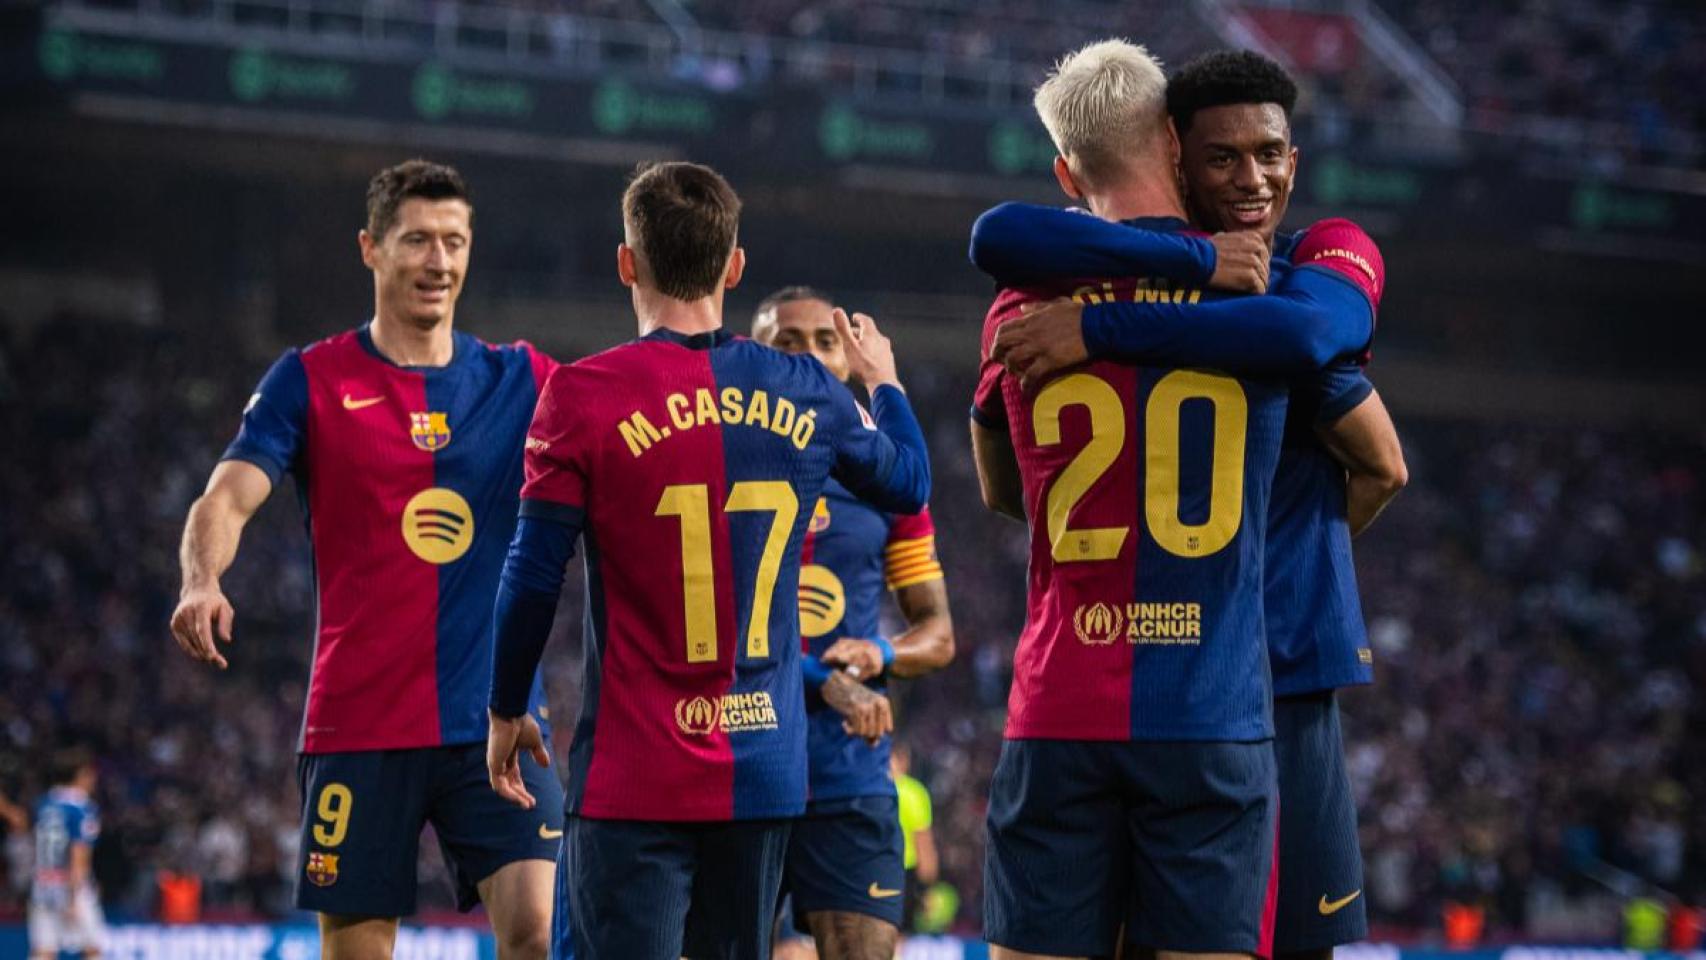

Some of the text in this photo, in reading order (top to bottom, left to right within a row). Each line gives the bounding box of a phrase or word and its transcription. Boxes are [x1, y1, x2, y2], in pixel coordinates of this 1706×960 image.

[1033, 370, 1248, 563] 20
[655, 481, 799, 663] 17
[1126, 603, 1201, 620] UNHCR
[1126, 620, 1201, 637] ACNUR
[720, 692, 773, 710] UNHCR
[719, 707, 777, 726] ACNUR
[313, 783, 352, 847] 9
